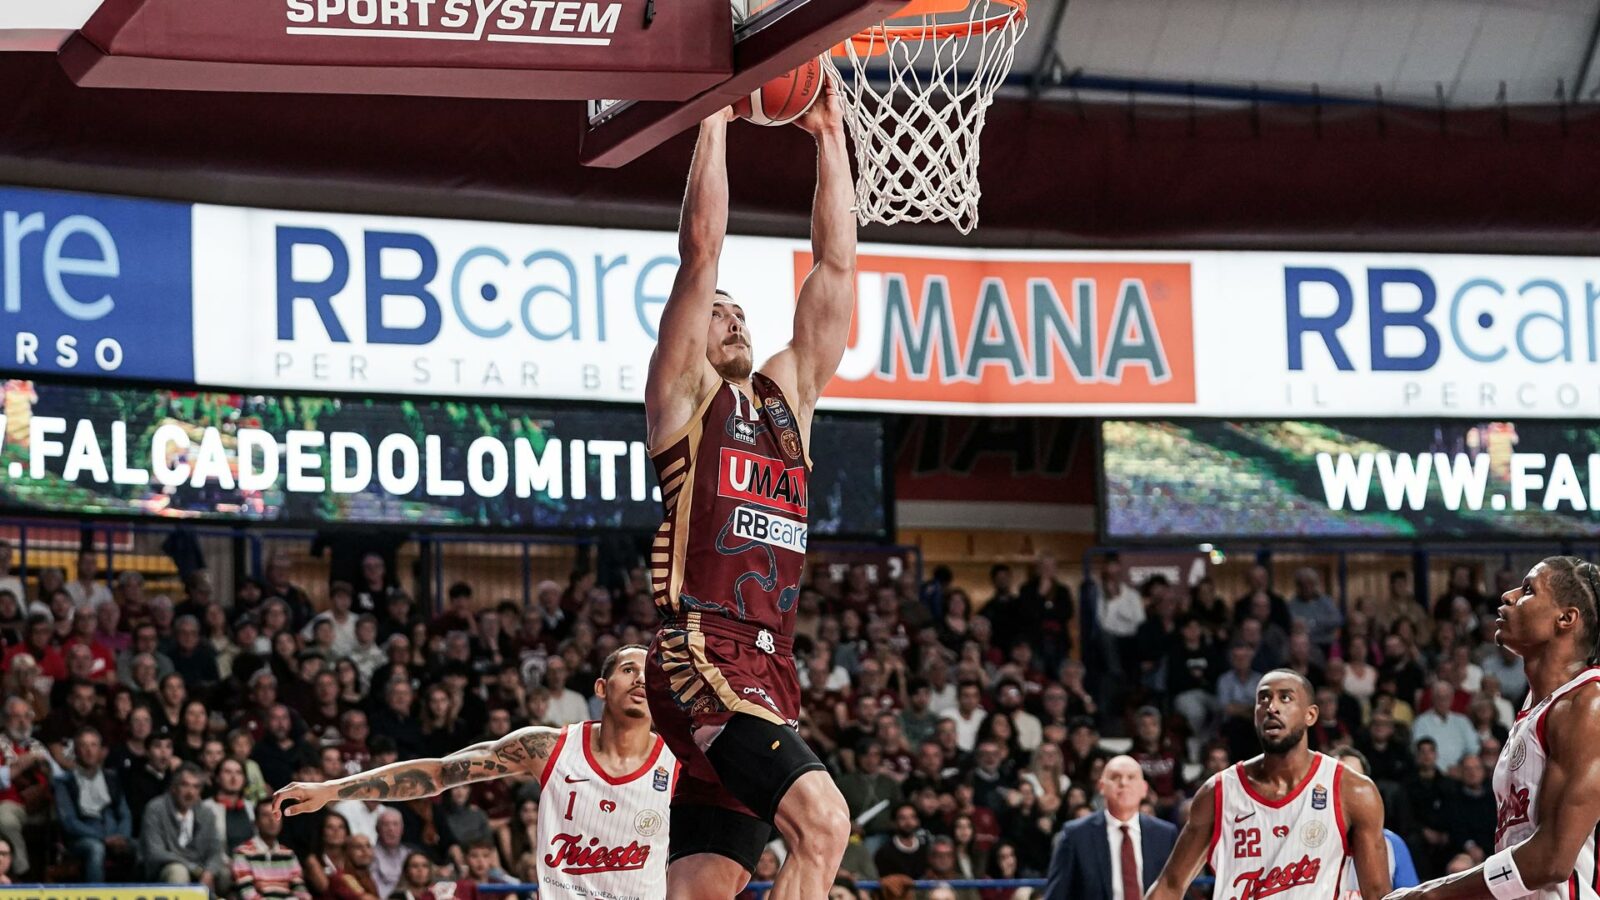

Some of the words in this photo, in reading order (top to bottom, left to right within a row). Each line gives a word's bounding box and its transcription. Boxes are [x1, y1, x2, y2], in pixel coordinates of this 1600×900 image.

[801, 58, 816, 97] olten
[275, 225, 681, 346] RBcare
[835, 272, 1173, 384] UMANA
[15, 332, 124, 371] RSO
[275, 352, 368, 380] PER
[413, 357, 541, 388] STAR
[1285, 383, 1328, 406] IL
[1404, 383, 1600, 408] PERCO
[0, 413, 662, 502] .FALCADEDOLOMITI.
[564, 791, 577, 821] 1
[544, 833, 651, 875] Trieste
[1234, 828, 1262, 858] 22
